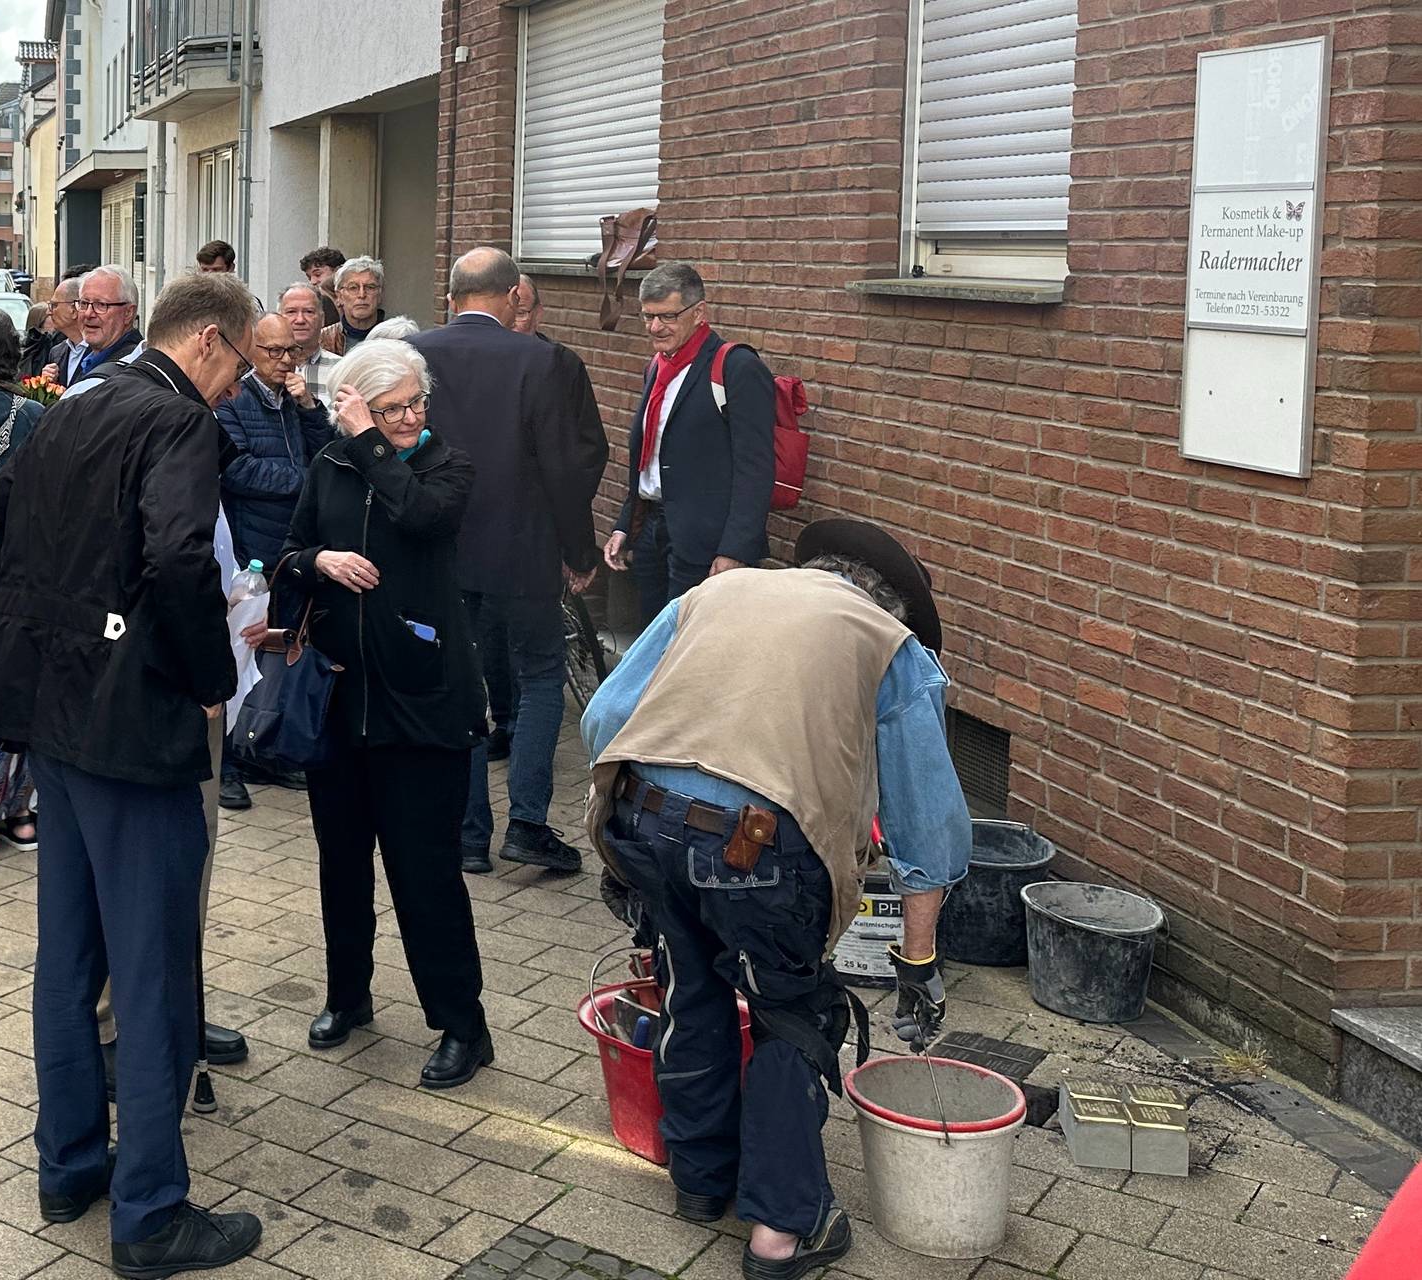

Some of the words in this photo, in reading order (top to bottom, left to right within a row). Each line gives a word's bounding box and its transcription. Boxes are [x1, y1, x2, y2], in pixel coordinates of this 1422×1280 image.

[1222, 206, 1270, 220] Kosmetik
[1272, 206, 1282, 220] &
[1201, 224, 1254, 238] Permanent
[1256, 224, 1304, 242] Make-up
[1199, 249, 1303, 272] Radermacher
[1194, 288, 1226, 300] Termine
[1227, 290, 1246, 301] nach
[1247, 290, 1304, 307] Vereinbarung
[1206, 302, 1234, 313] Telefon
[1235, 303, 1290, 317] 02251-53322
[854, 921, 901, 929] Kaltmischgut
[843, 960, 855, 968] 25
[857, 962, 868, 970] kg
